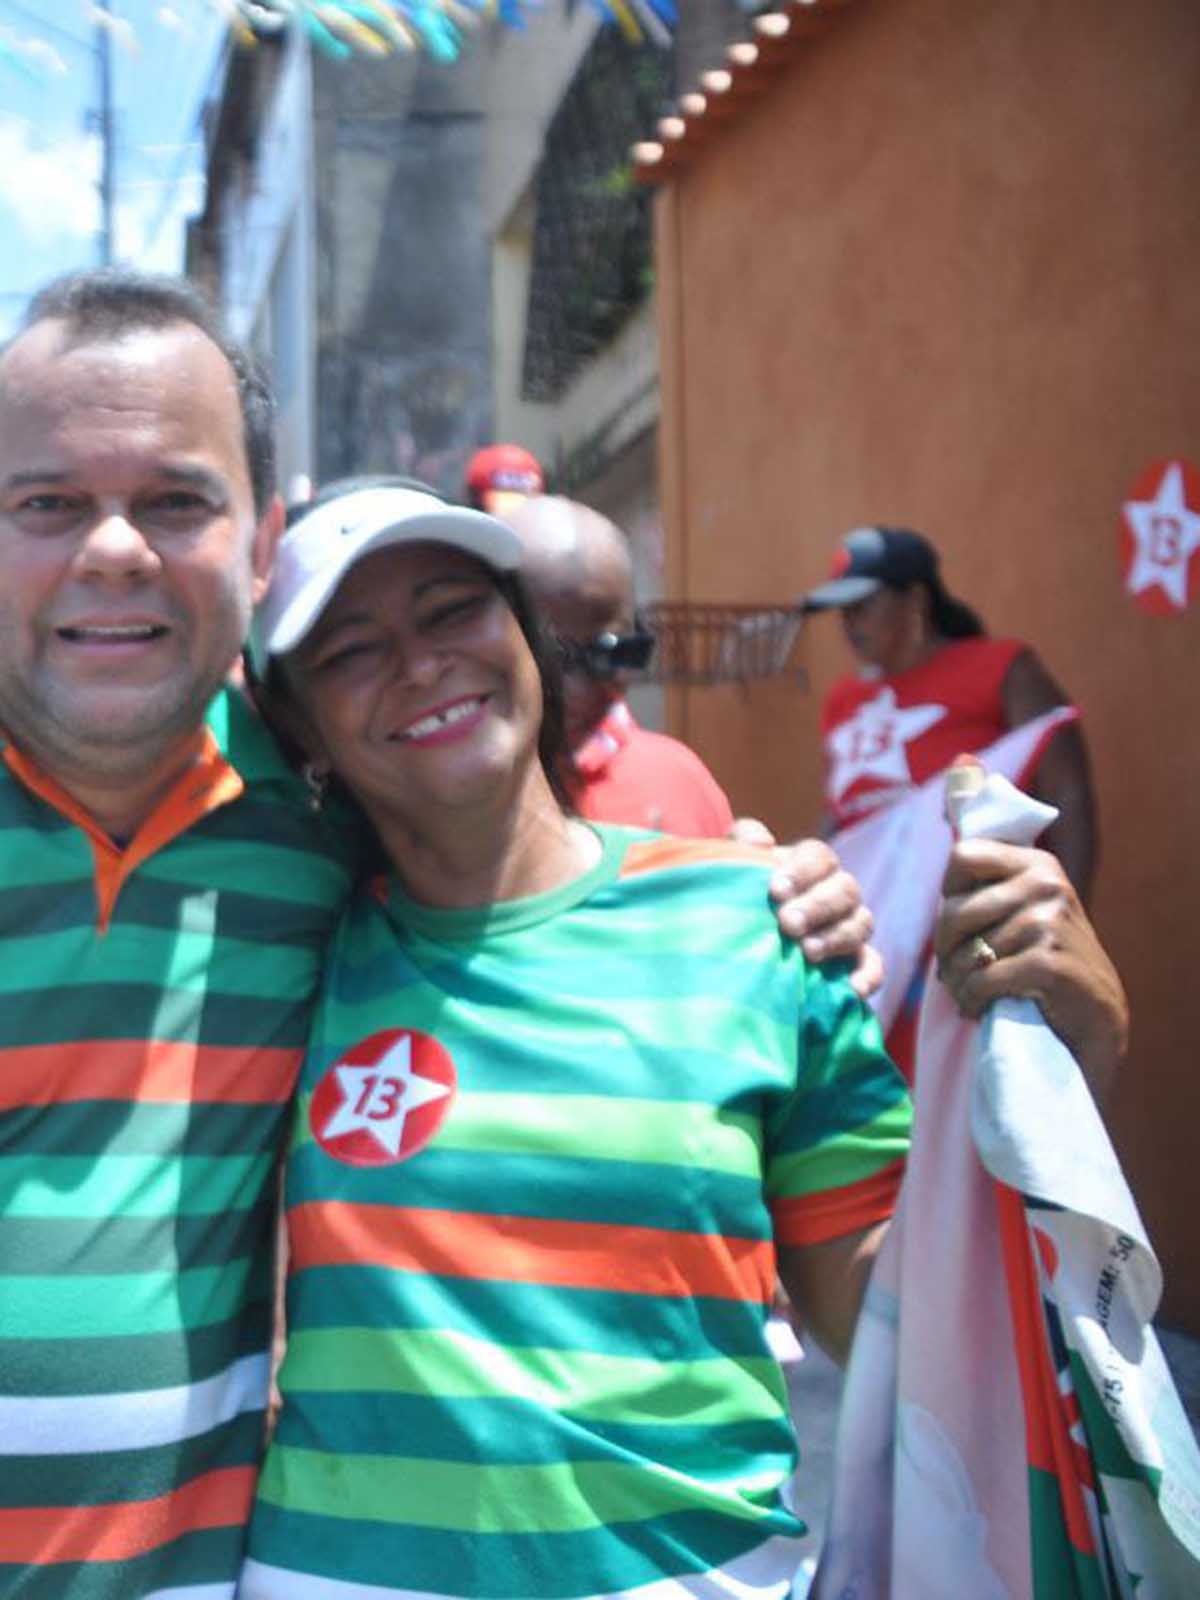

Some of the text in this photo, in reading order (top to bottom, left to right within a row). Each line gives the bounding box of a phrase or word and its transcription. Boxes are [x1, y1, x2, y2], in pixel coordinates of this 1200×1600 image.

[1150, 515, 1184, 567] 13
[849, 719, 894, 763] 13
[353, 1075, 407, 1120] 13
